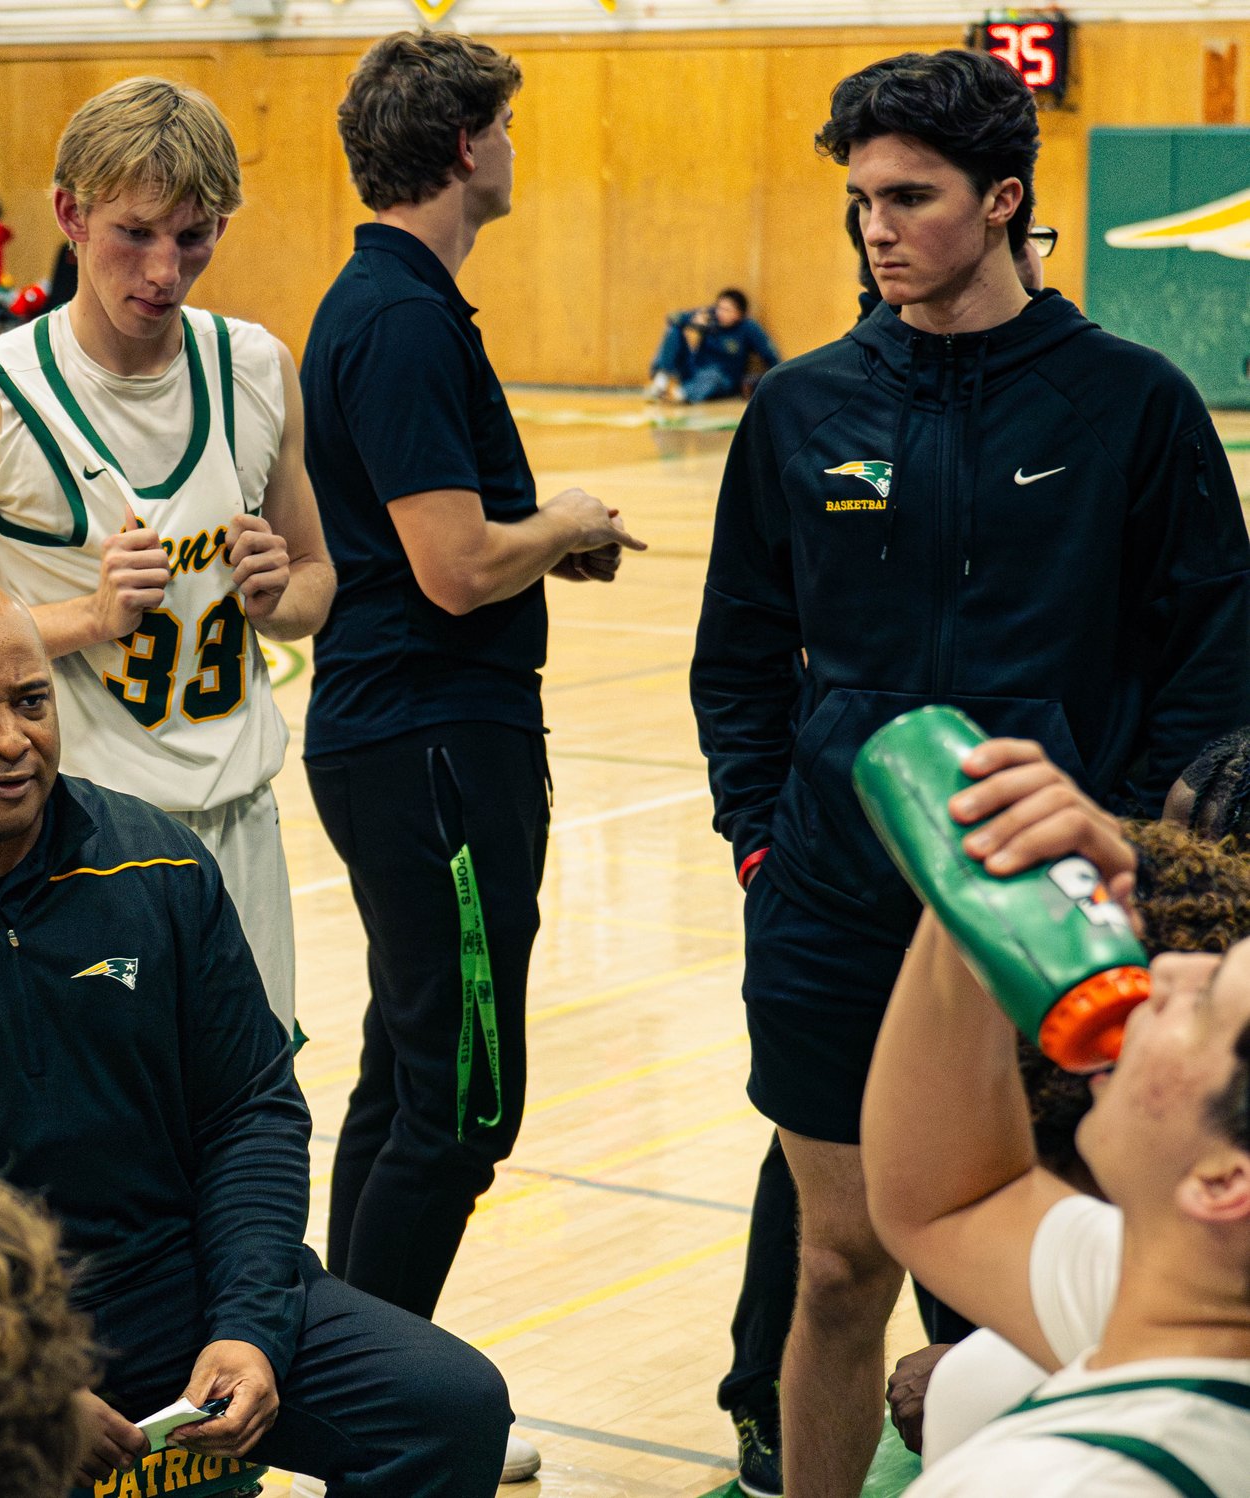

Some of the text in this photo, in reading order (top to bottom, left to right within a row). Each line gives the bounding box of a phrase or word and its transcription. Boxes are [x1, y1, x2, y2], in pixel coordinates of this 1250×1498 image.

[987, 22, 1056, 88] 35
[825, 499, 888, 511] BASKETBAL
[103, 592, 249, 732] 33
